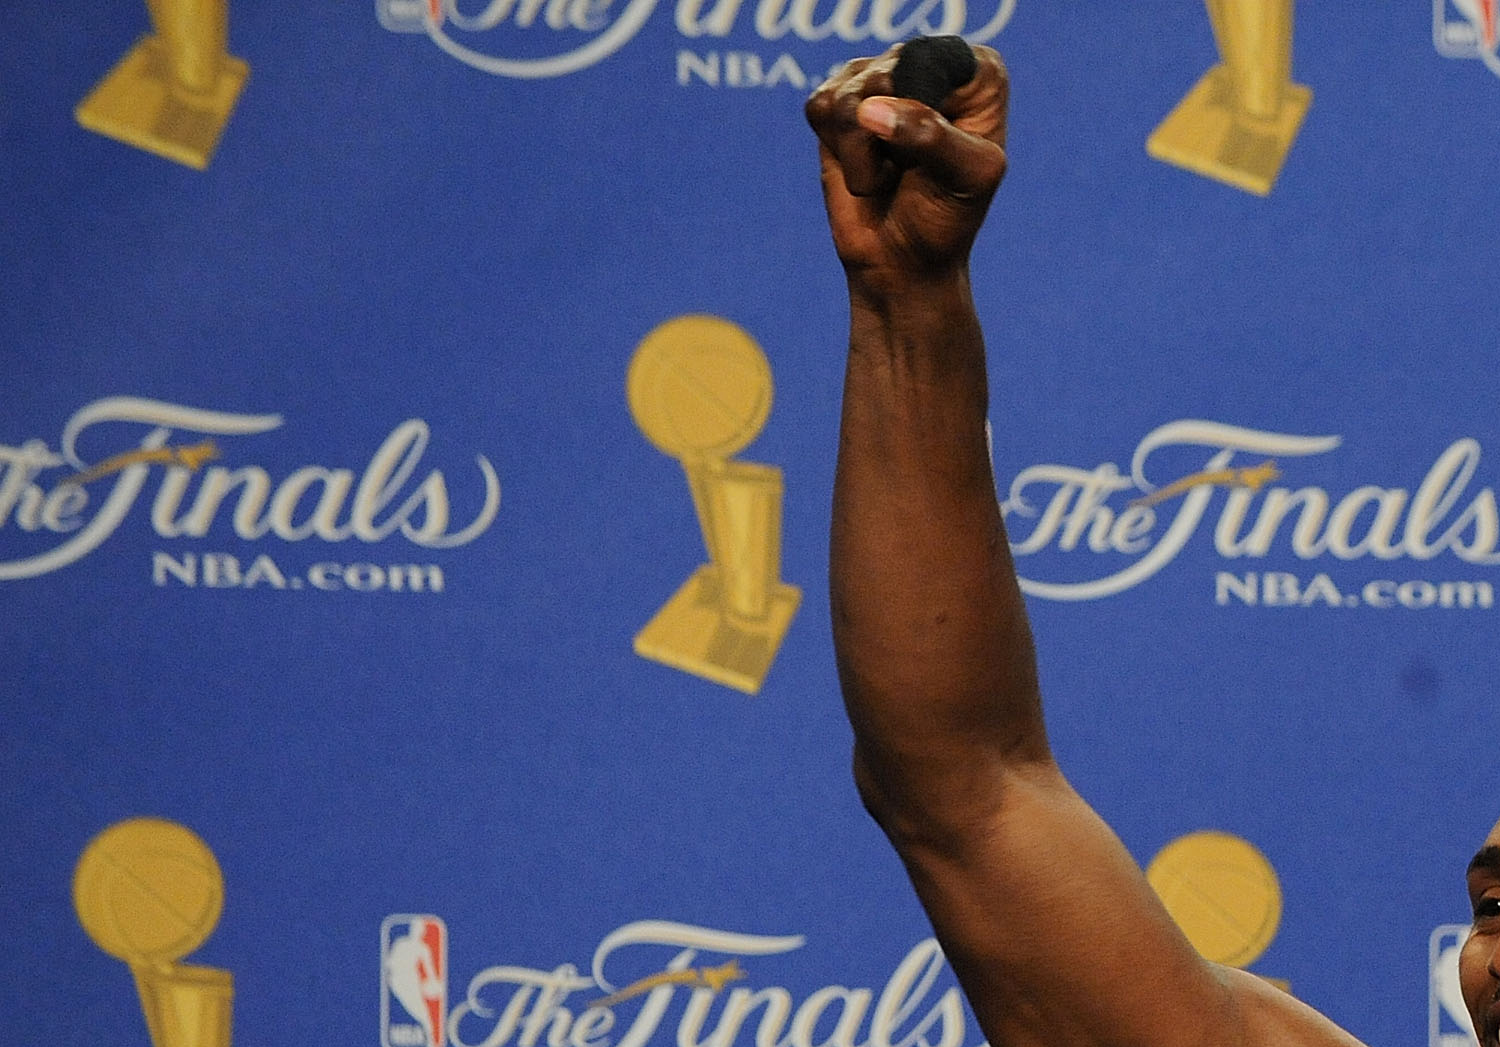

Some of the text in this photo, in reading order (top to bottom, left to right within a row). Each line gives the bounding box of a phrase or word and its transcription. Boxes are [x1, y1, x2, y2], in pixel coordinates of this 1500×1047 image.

[676, 51, 842, 88] NBA.
[0, 396, 501, 580] he Finals
[1001, 462, 1156, 556] The
[152, 550, 446, 593] NBA.com
[1214, 570, 1495, 608] NBA.com
